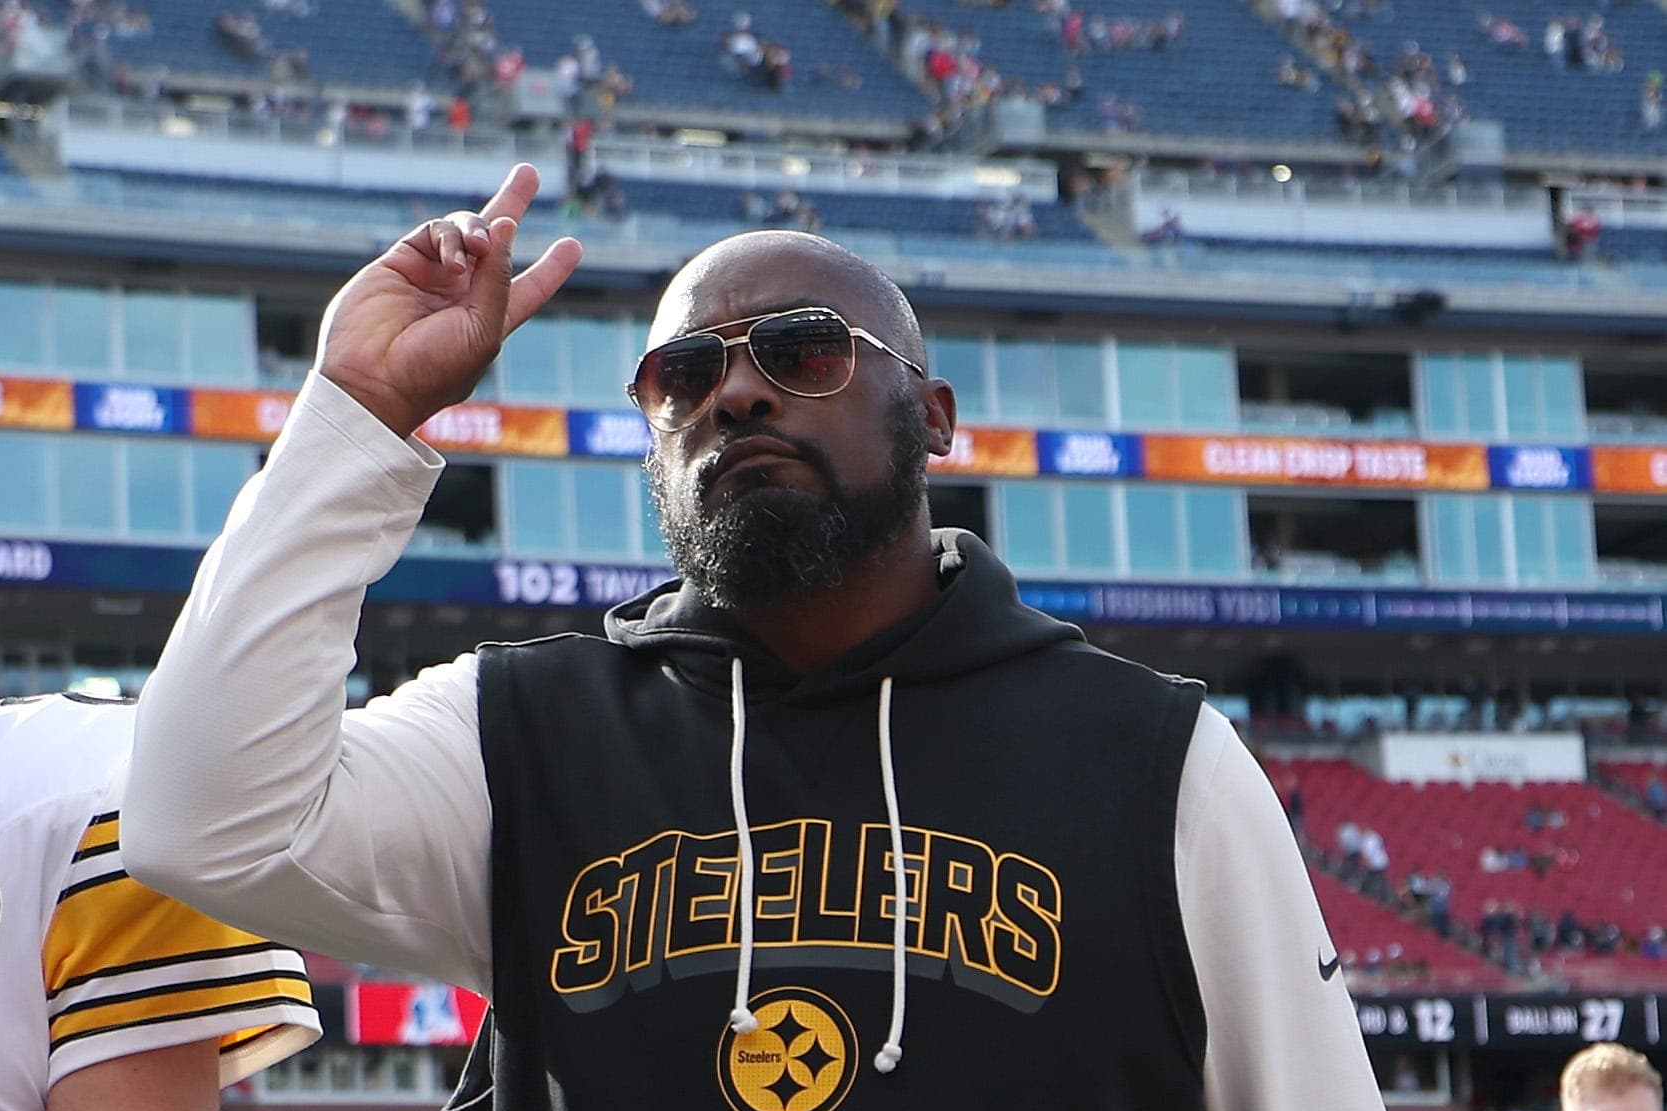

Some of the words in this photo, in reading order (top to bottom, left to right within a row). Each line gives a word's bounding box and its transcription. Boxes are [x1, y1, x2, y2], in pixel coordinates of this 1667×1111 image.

[1202, 438, 1282, 476] CLEAN
[1282, 443, 1353, 479] CRISP
[1353, 444, 1428, 481] TASTE
[497, 561, 580, 604] 102
[550, 819, 1062, 1002] STEELERS
[1412, 998, 1455, 1042] 12
[1505, 1004, 1550, 1036] BALL
[1581, 998, 1625, 1042] 27
[737, 1049, 783, 1064] Steelers
